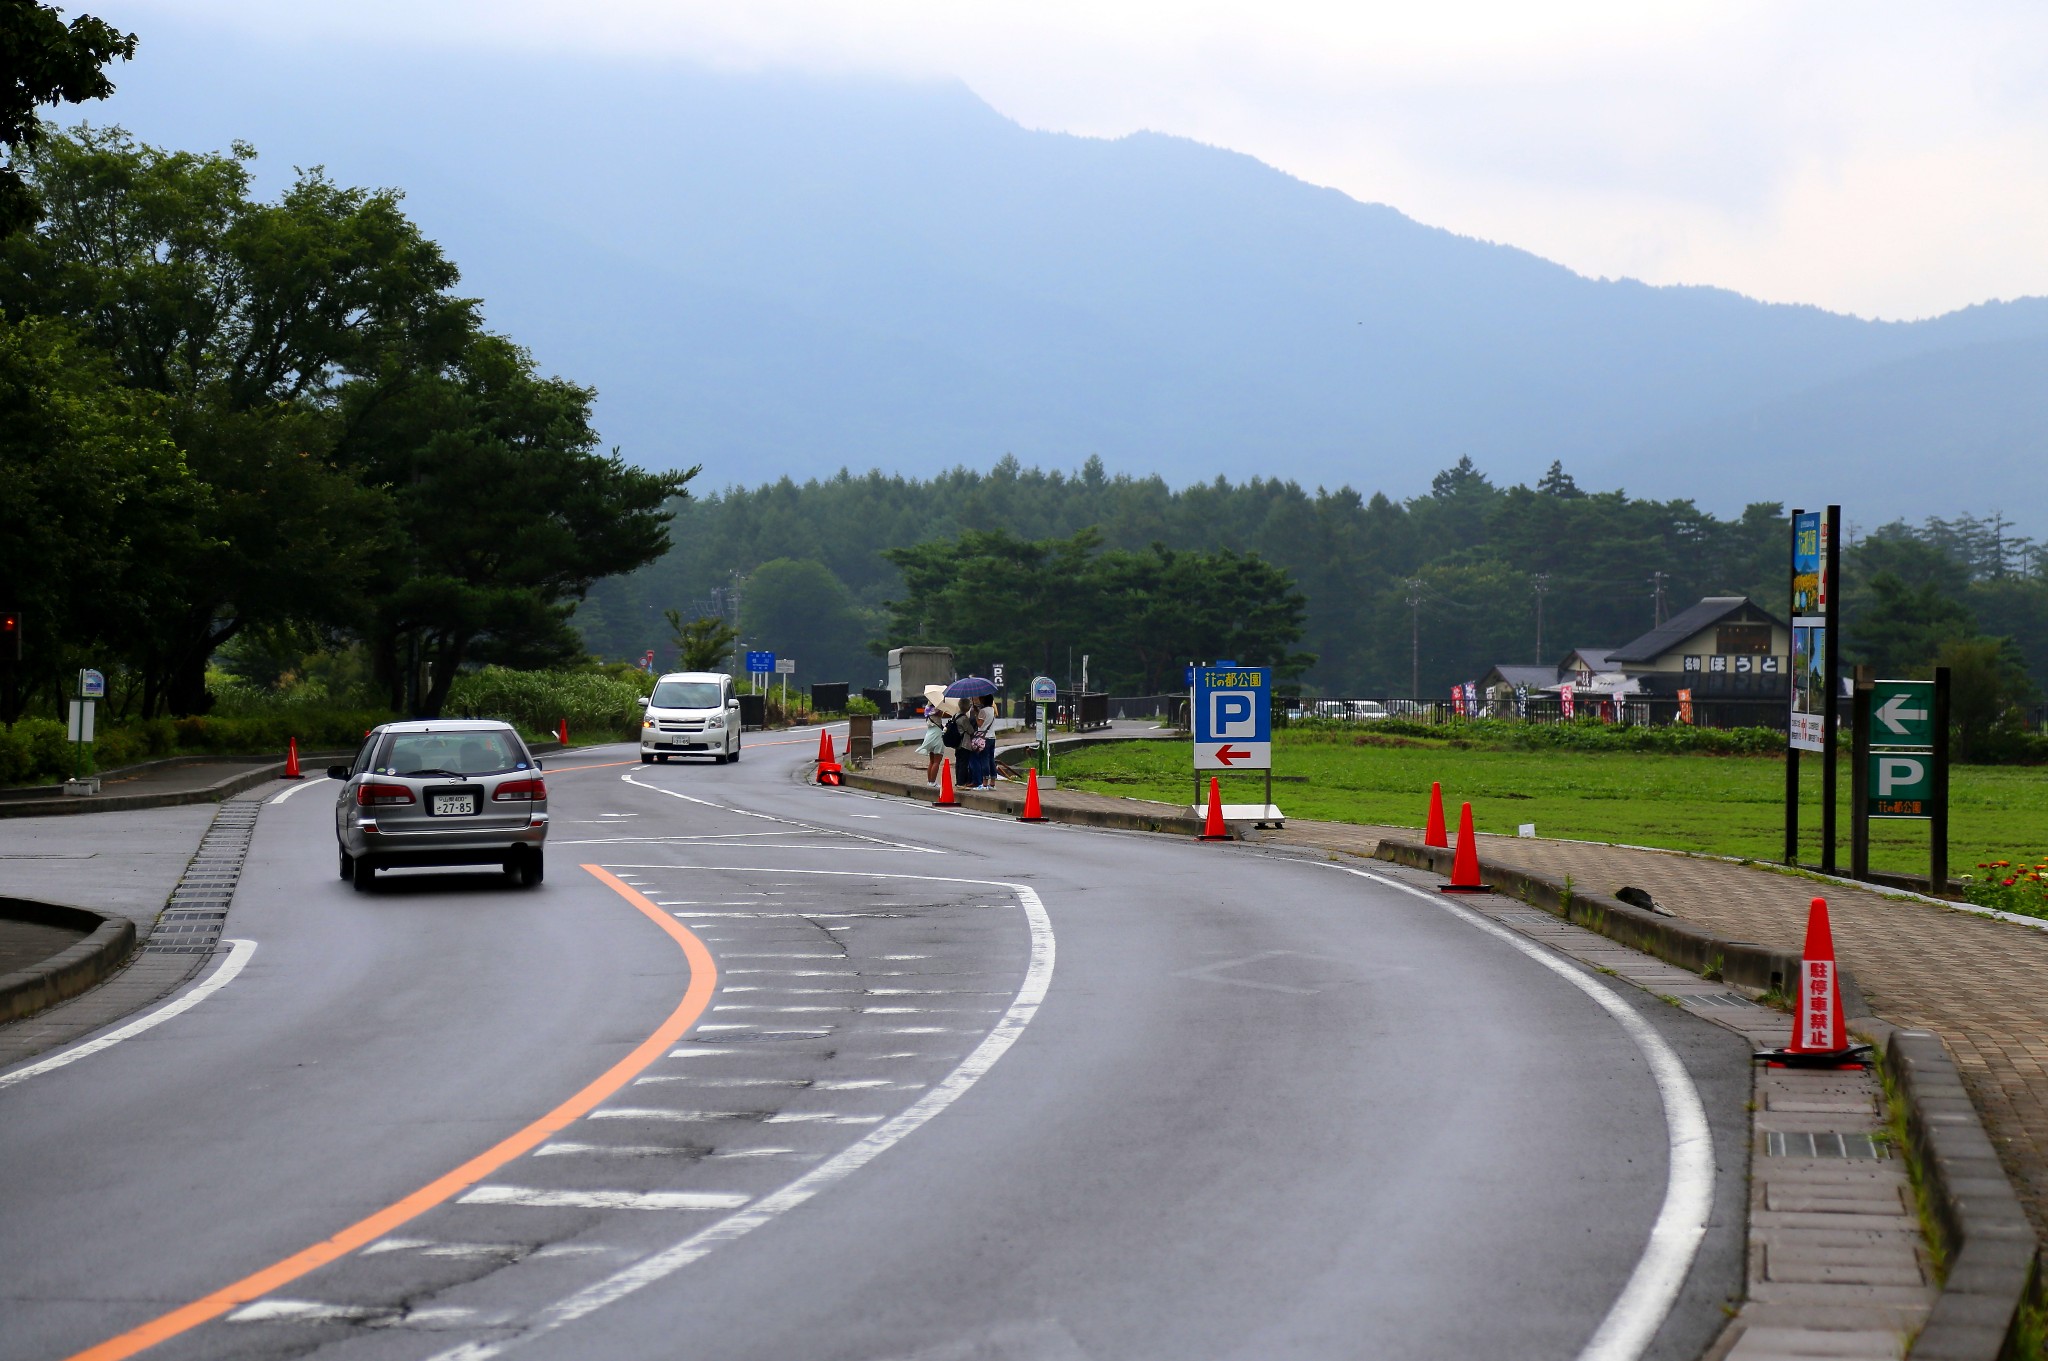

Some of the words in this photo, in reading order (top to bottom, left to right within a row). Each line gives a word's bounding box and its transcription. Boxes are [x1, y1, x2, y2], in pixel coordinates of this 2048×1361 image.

[1205, 672, 1261, 687] 花の都公園
[1216, 695, 1250, 734] P
[1878, 758, 1924, 796] P
[1878, 801, 1921, 813] 花の都公園
[1810, 963, 1828, 1046] 駐停車禁止
